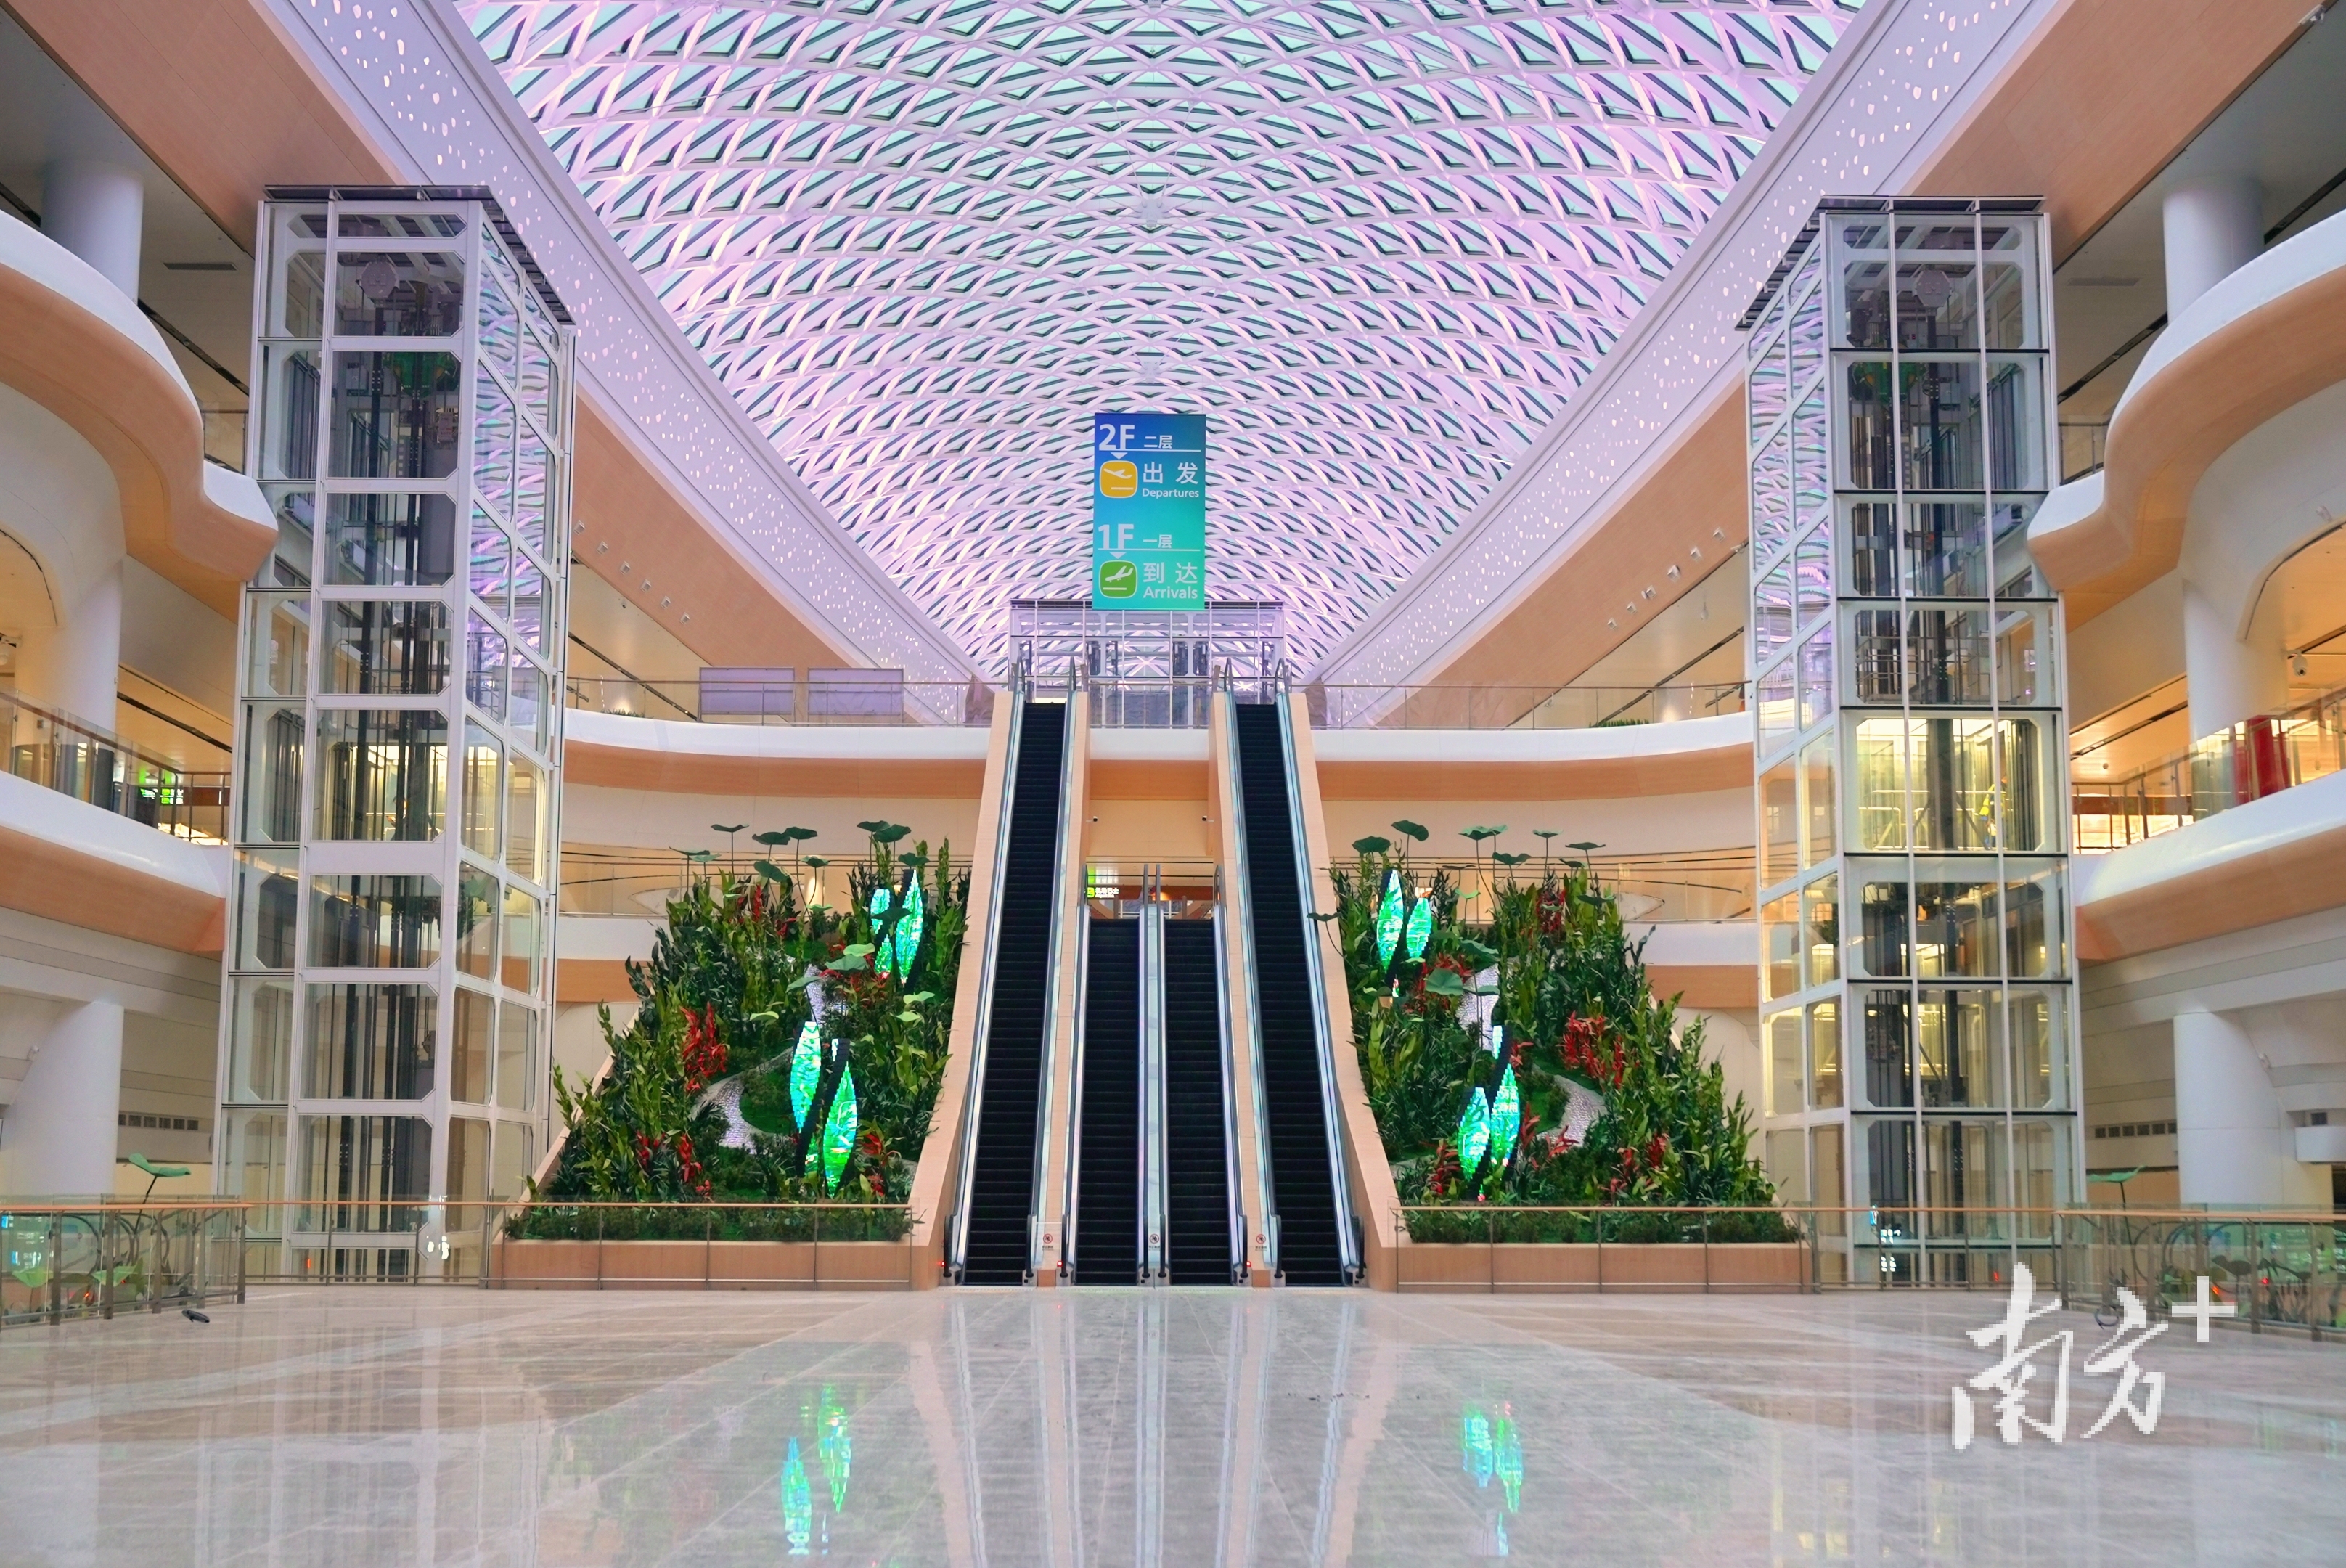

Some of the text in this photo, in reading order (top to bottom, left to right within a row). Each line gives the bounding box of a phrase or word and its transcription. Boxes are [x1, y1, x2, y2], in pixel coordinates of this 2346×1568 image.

[1098, 423, 1173, 451] 2F 二层
[1143, 461, 1199, 485] 出发
[1142, 488, 1200, 499] Departures
[1098, 523, 1172, 550] 1F 一层
[1143, 562, 1198, 584] 到达
[1143, 586, 1198, 600] Arrivals
